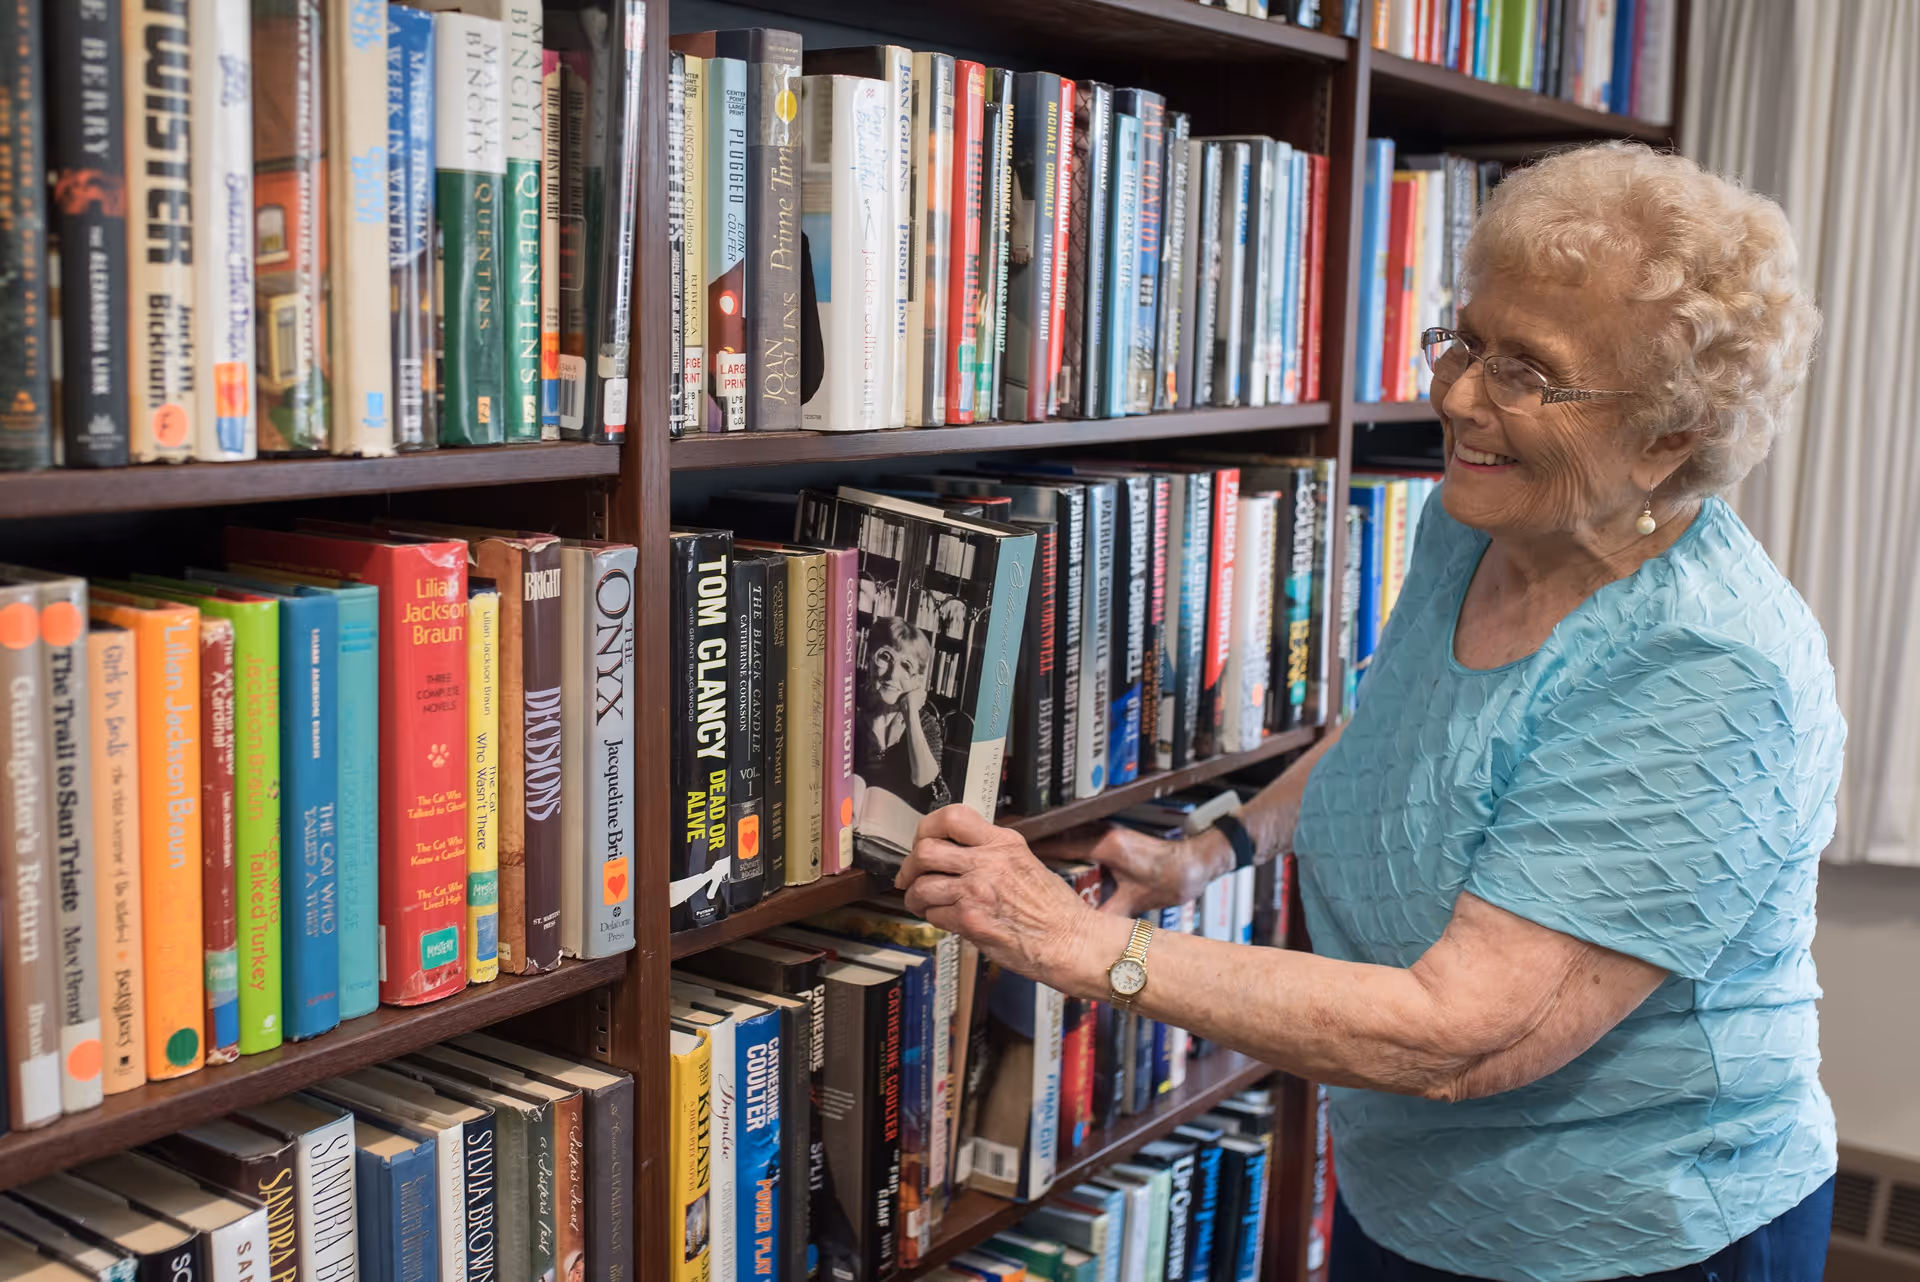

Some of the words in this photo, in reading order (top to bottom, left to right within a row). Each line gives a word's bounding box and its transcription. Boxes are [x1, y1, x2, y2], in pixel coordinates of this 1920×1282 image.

[81, 38, 110, 153] BERRY
[388, 45, 404, 115] WEEK
[465, 31, 483, 160] BINCHY
[511, 9, 529, 145] BINCHY
[547, 87, 560, 108] THE
[726, 89, 746, 97] CENTER
[899, 64, 912, 109] JOAN
[547, 112, 560, 145] HOME
[1003, 103, 1014, 160] MICHAEL
[1047, 101, 1058, 156] MICHAEL
[1062, 111, 1073, 167] MICHAEL
[1102, 92, 1110, 135] MICHAEL
[388, 129, 404, 154] IN
[685, 125, 696, 181] KINGDOM
[730, 129, 744, 204] PLUGGED
[900, 114, 912, 192] COLLINS
[1101, 140, 1109, 190] CONNELLY
[388, 166, 408, 265] WINTER
[1000, 165, 1013, 232] CONNELLY
[1045, 162, 1056, 218] CONNELLY
[1059, 171, 1071, 233] CONNELLY
[684, 198, 695, 257] Childhood
[728, 213, 738, 262] COLFER
[737, 222, 745, 255] EOIN
[770, 197, 794, 272] Prime
[998, 241, 1009, 263] THE
[1043, 233, 1052, 255] THE
[475, 181, 493, 330] QUENTINS
[515, 171, 541, 384] QUENTINS
[897, 225, 909, 287] PRIME
[1041, 257, 1052, 288] GODS
[997, 265, 1008, 302] BRASS
[1041, 291, 1050, 304] OF
[863, 313, 877, 370] collins
[995, 305, 1007, 353] VERDICT
[763, 338, 787, 405] JOAN
[1069, 493, 1084, 564] PATRICIA
[1099, 500, 1112, 571] PATRICIA
[1131, 483, 1149, 575] PATRICIA
[1223, 482, 1240, 562] PATRICIA
[524, 569, 560, 601] BRIGHT
[697, 555, 727, 627] TOM
[1042, 532, 1058, 597] PATRICIA
[482, 611, 493, 638] Lilian
[688, 606, 696, 626] with
[752, 585, 762, 620] THE
[806, 565, 819, 657] COOKSON
[845, 577, 854, 664] COOKSON
[1066, 565, 1082, 645] CORNWELL
[1096, 576, 1110, 664] CORNWELL
[1127, 576, 1146, 683] CORNWELL
[1217, 564, 1235, 665] CORNWELL
[164, 623, 191, 690] Lilian
[413, 625, 463, 645] Braun
[482, 641, 493, 684] Jackson
[596, 568, 632, 727] ONYX
[624, 622, 634, 665] THE
[688, 628, 696, 661] GRANT
[740, 614, 748, 678] CATHERINE
[753, 628, 762, 680] BLACK
[1039, 599, 1056, 676] CORNWELL
[52, 646, 75, 697] The
[212, 671, 224, 685] A
[265, 664, 279, 728] Lilian
[688, 663, 697, 722] BLACKWOOD
[696, 637, 727, 759] CLANCY
[844, 672, 853, 715] THE
[211, 687, 227, 748] Cardinal
[246, 653, 264, 750] Jackson
[482, 685, 493, 716] Braun
[740, 679, 748, 732] COOKSON
[752, 688, 761, 753] CANDLE
[1093, 669, 1107, 758] SCARPETTA
[53, 698, 77, 759] Trail
[165, 696, 194, 796] Jackson
[476, 732, 488, 763] Who
[524, 686, 561, 822] DECISIONS
[57, 763, 77, 788] to
[247, 754, 266, 819] Braun
[489, 765, 498, 787] The
[604, 738, 624, 829] Jacqueline
[739, 768, 761, 780] VOL.
[774, 734, 783, 786] NYMPH
[57, 789, 79, 839] San
[417, 796, 431, 806] The
[433, 793, 446, 803] Cat
[446, 790, 461, 801] Who
[436, 807, 445, 815] to
[475, 769, 489, 810] Wasn't
[489, 792, 498, 813] Cat
[687, 791, 706, 843] ALIVE
[709, 769, 727, 818] DEAD
[168, 797, 195, 868] Braun
[319, 802, 335, 838] THE
[416, 843, 432, 853] The
[433, 840, 446, 850] Cat
[447, 836, 463, 847] Who
[475, 813, 489, 850] There
[709, 822, 727, 851] OR
[59, 839, 82, 912] Triste
[268, 836, 280, 870] Cat
[305, 872, 318, 889] A
[319, 843, 335, 877] CAT
[20, 861, 42, 964] Return
[250, 850, 268, 920] Talked
[319, 882, 336, 935] WHO
[416, 889, 432, 900] The
[433, 886, 446, 897] Cat
[447, 882, 463, 894] Who
[423, 900, 445, 911] Lived
[445, 893, 461, 905] High
[426, 939, 455, 958] MYSTERY
[543, 920, 556, 931] PRESS
[600, 919, 630, 933] Delacorte
[608, 933, 625, 943] Press
[248, 921, 269, 992] Turkey
[811, 984, 826, 1073] CATHERINE
[886, 987, 899, 1073] CATHERINE
[746, 1043, 768, 1133] COULTER
[765, 1037, 780, 1125] CATHERINE
[884, 1074, 899, 1142] COULTER
[540, 1136, 548, 1149] a
[571, 1112, 579, 1121] a
[696, 1089, 710, 1191] KHAN
[711, 1073, 736, 1160] Impulse
[451, 1139, 462, 1172] NOT
[467, 1130, 493, 1206] SYLVIA
[569, 1125, 583, 1183] Sister's
[809, 1142, 824, 1190] SPLIT
[311, 1133, 354, 1253] SANDRA
[452, 1173, 462, 1215] EVEN
[537, 1152, 553, 1215] Sister's
[569, 1185, 583, 1233] Secret
[755, 1179, 773, 1234] POWER
[258, 1167, 295, 1267] SANDRA
[453, 1215, 463, 1247] FOR
[755, 1236, 772, 1275] PLAY
